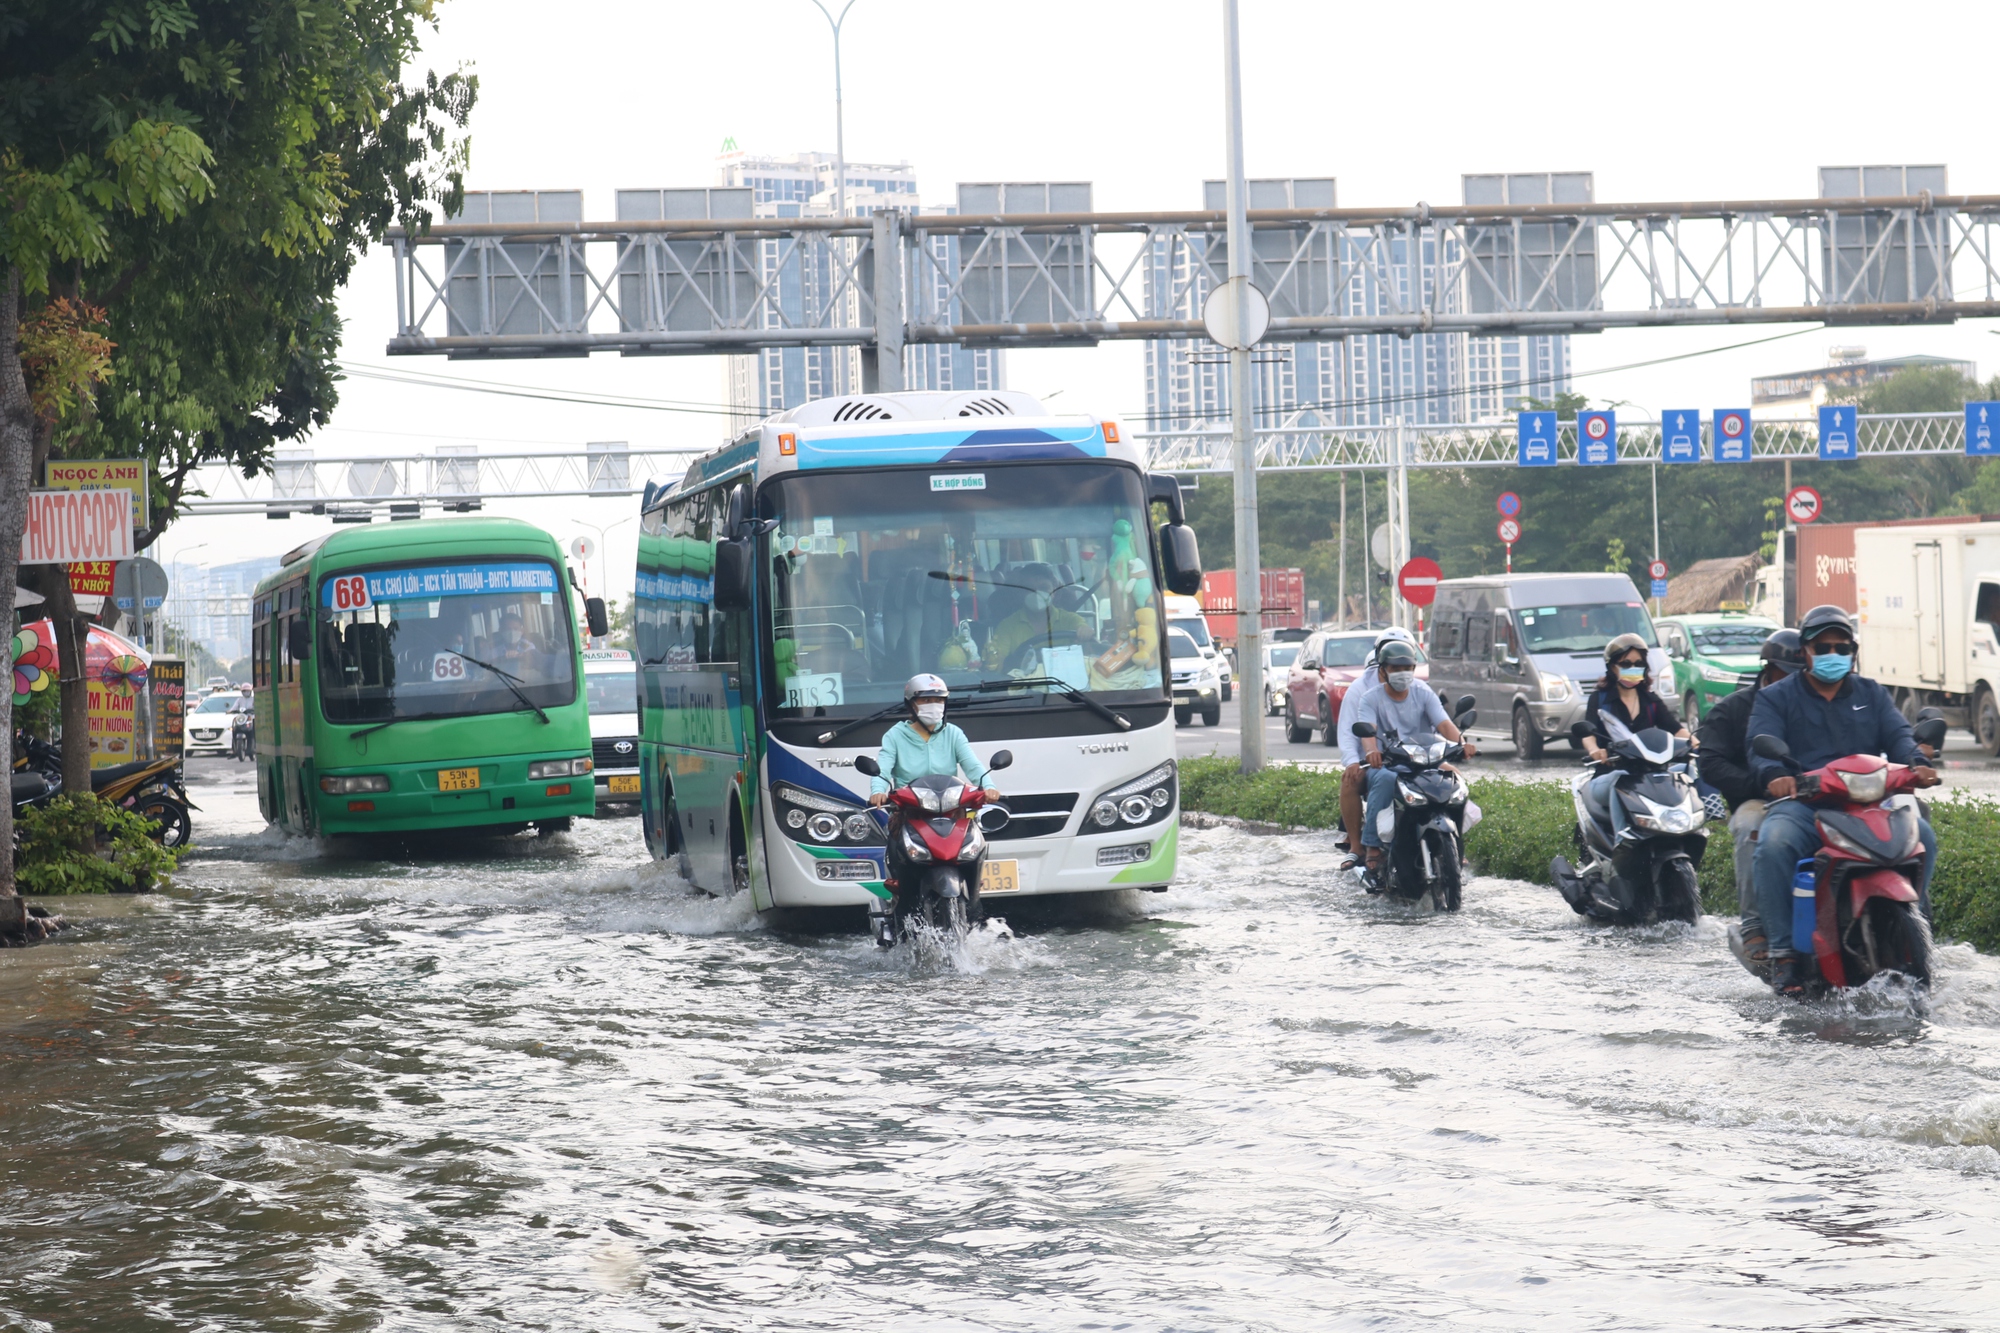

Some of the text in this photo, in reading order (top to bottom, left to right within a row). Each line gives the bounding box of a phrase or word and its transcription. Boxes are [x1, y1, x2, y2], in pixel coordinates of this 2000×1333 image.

[1592, 423, 1602, 433] 80
[1727, 422, 1738, 432] 60
[53, 465, 139, 482] NGỌC ÁNH
[933, 480, 943, 488] XE
[90, 562, 110, 576] XE
[82, 577, 111, 592] NHỚT
[370, 579, 384, 596] BX.
[385, 575, 403, 597] CHỢ
[441, 570, 456, 590] TÂN
[510, 570, 553, 588] MARKETING
[335, 577, 367, 609] 68
[583, 652, 612, 660] INASUN
[152, 665, 183, 679] Thái
[434, 656, 463, 678] 68
[788, 677, 840, 708] BUS 3
[88, 717, 104, 734] THỊT
[1077, 741, 1129, 755] TOWN
[816, 756, 876, 768] THA
[449, 770, 467, 780] 53N
[443, 779, 476, 790] 7169
[984, 862, 1000, 876] 1B
[982, 876, 1012, 890] 0.33
